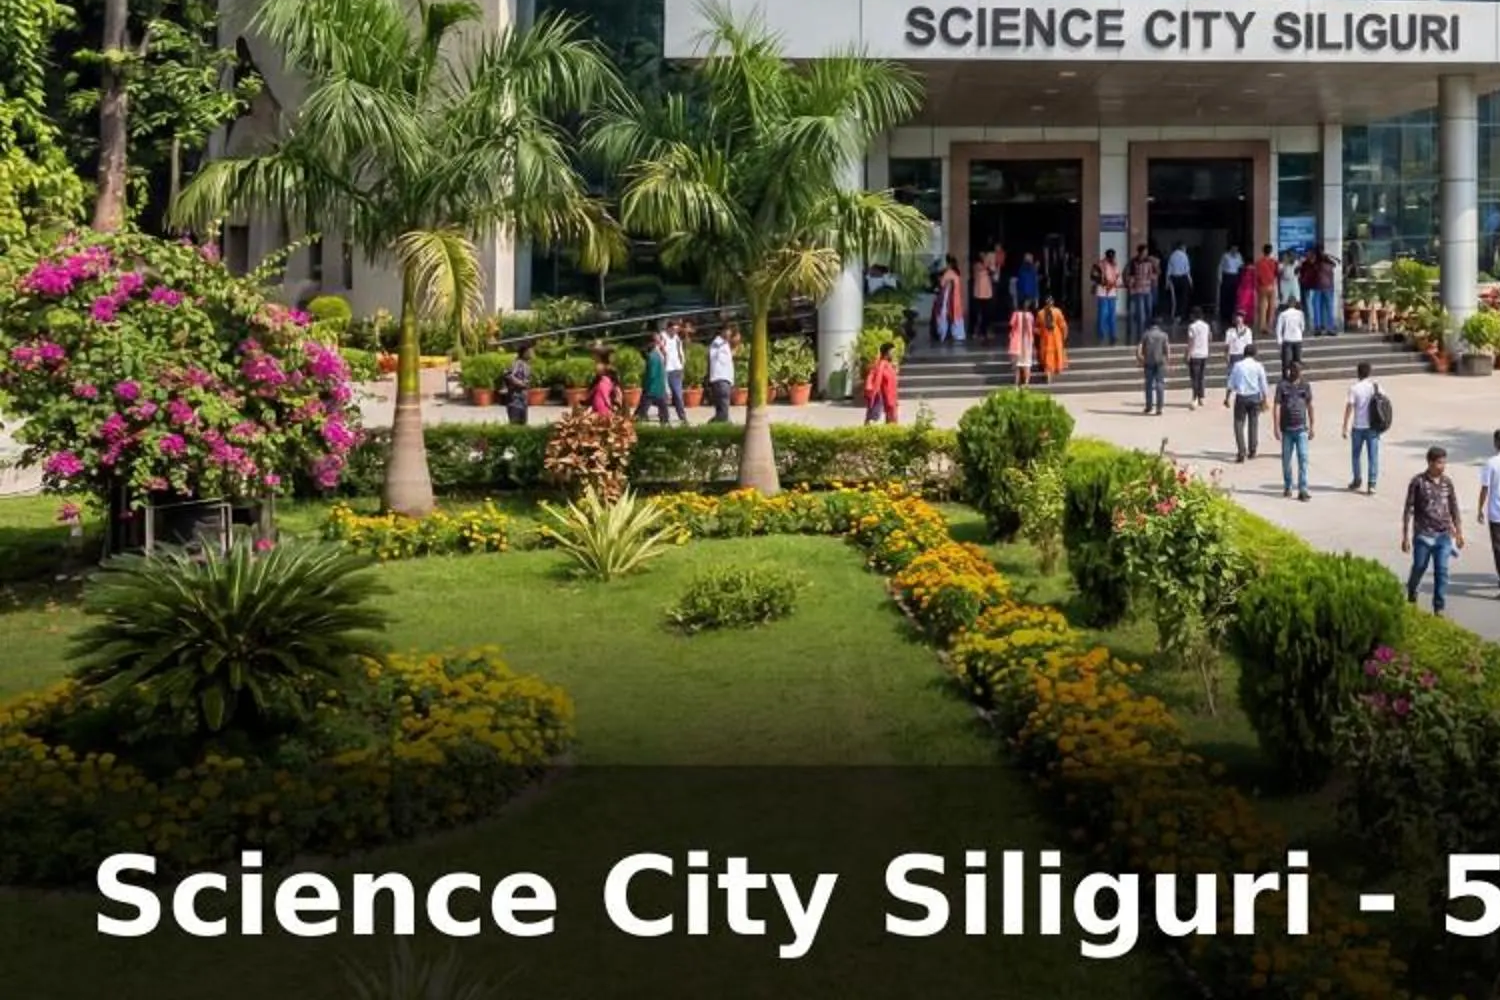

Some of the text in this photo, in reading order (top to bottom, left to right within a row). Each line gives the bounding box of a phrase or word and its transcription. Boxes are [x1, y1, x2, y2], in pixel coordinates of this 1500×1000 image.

[905, 6, 1459, 51] SCIENCE CITY SILIGURI
